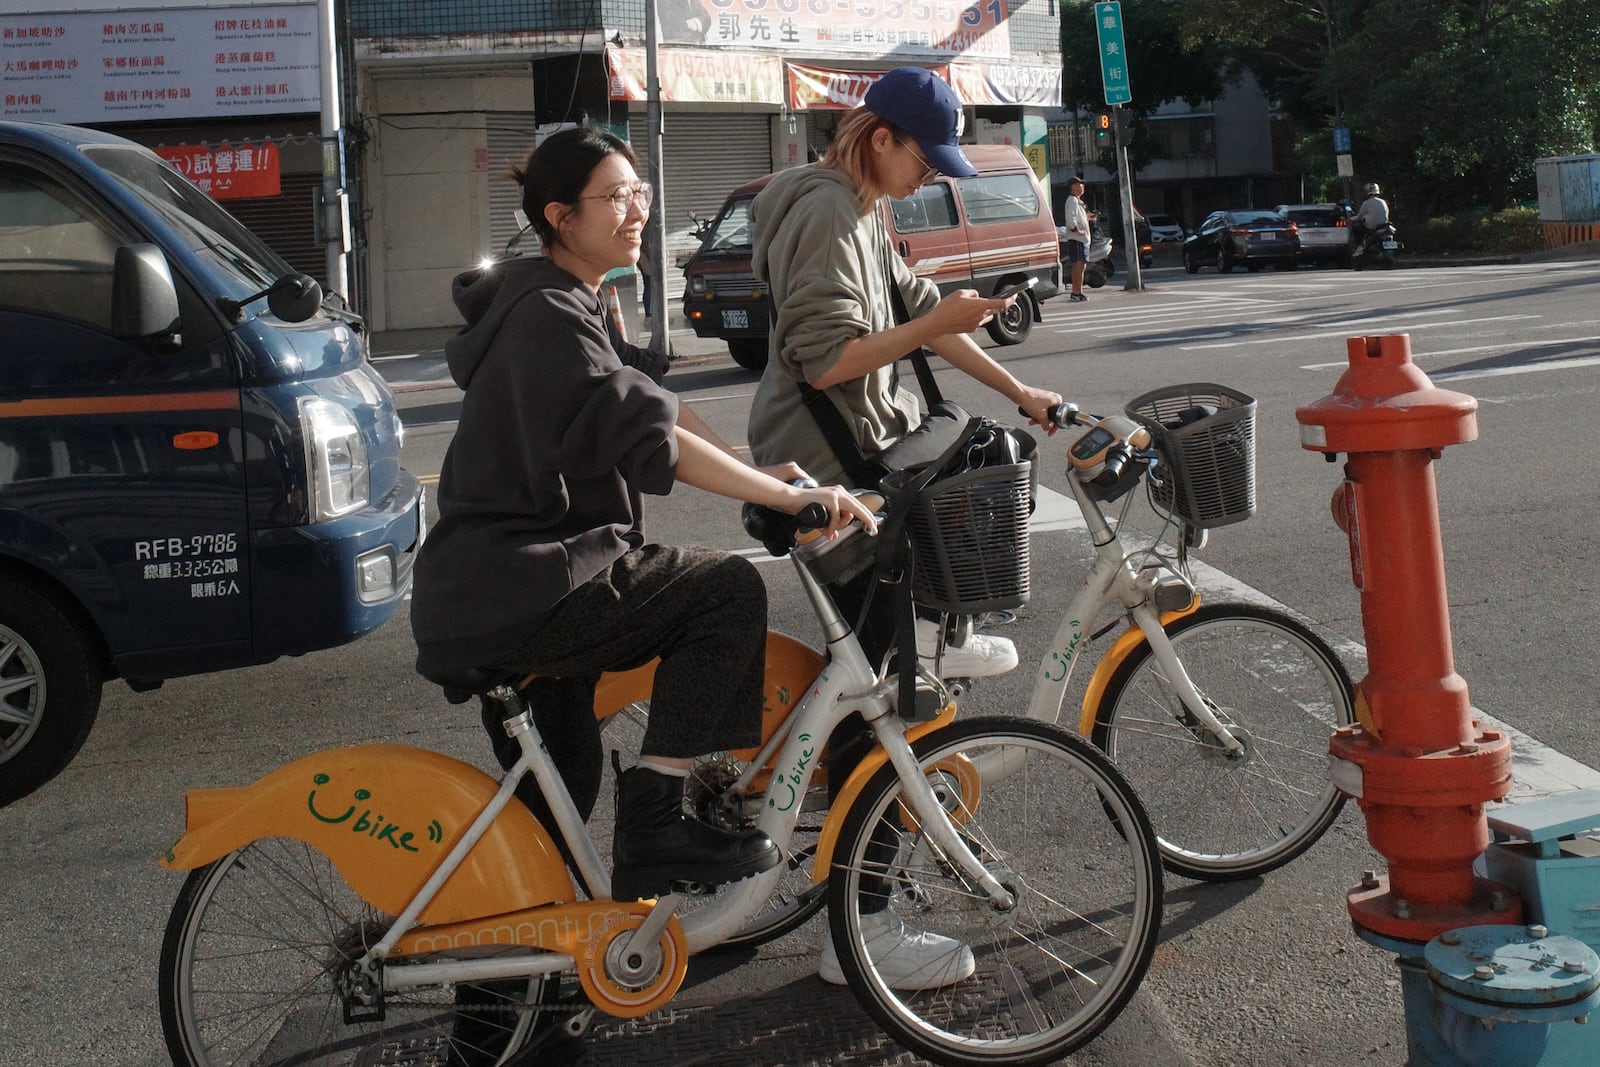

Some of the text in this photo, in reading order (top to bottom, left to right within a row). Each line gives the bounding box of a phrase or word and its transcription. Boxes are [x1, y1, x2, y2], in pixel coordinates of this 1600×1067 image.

[103, 23, 164, 35] 豬肉苦瓜湯
[214, 17, 287, 31] 招牌花枝油條
[718, 12, 800, 43] 郭先生
[4, 26, 65, 38] 新加坡叻沙
[1103, 16, 1121, 80] 華美街
[104, 88, 190, 102] 越南牛肉河粉湯
[215, 83, 289, 97] 港式蜜汁鳳爪
[135, 533, 237, 561] RFB-9786
